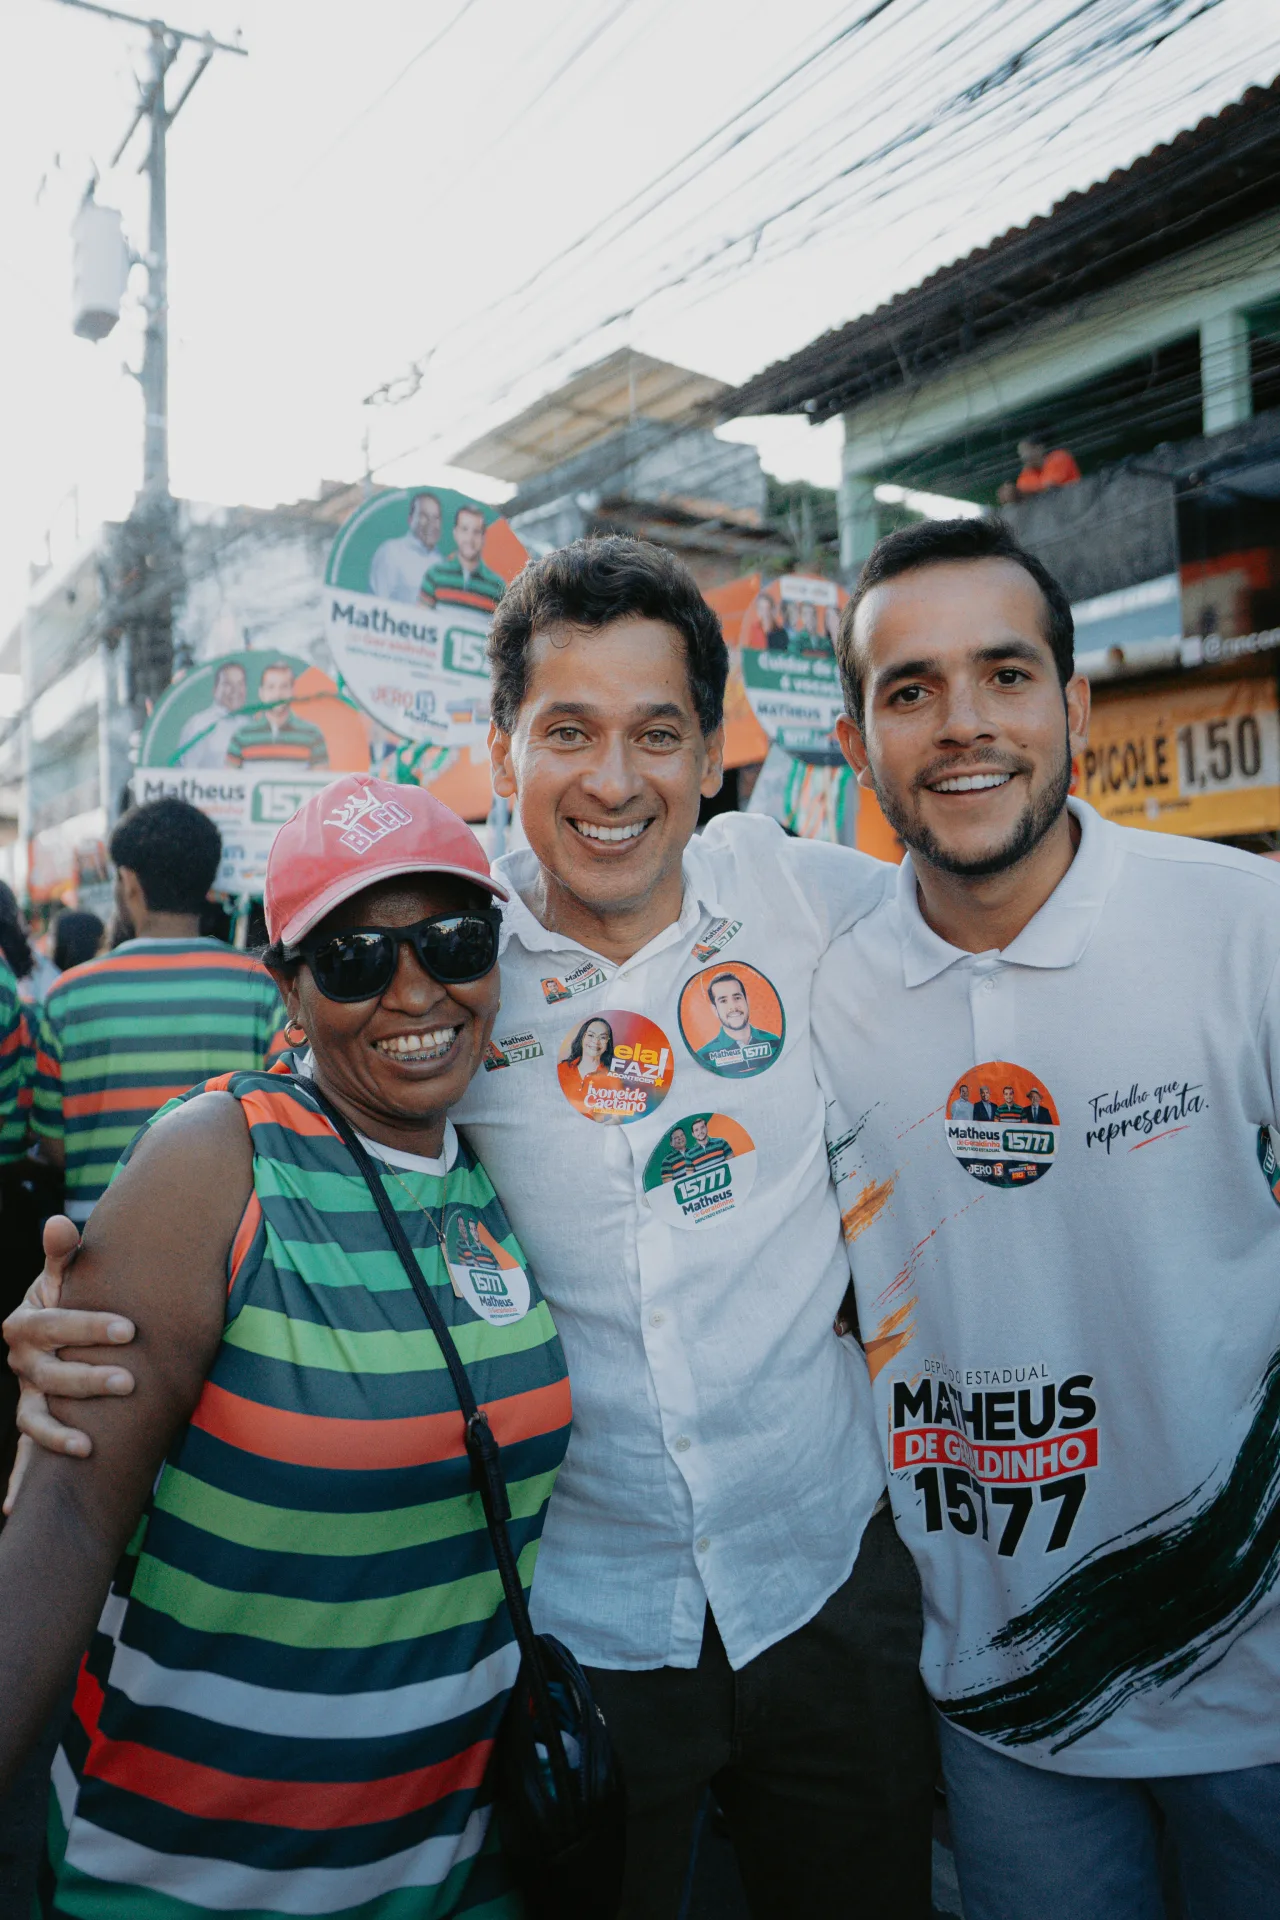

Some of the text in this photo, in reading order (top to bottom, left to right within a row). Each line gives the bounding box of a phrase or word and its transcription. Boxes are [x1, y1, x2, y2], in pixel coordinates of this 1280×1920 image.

[332, 601, 438, 644] Matheus
[1084, 714, 1262, 796] PICOLÉ 1,50
[143, 778, 246, 800] Matheus
[564, 962, 594, 983] Matheus
[500, 1034, 534, 1048] Matheus
[709, 1048, 741, 1060] Matheus
[743, 1044, 769, 1059] 15777
[505, 1042, 542, 1063] 15777
[613, 1043, 659, 1065] ela
[607, 1072, 655, 1085] ACONTECER
[583, 1094, 647, 1113] Caetano
[1088, 1081, 1179, 1123] Trabalho que
[1086, 1082, 1209, 1155] representa.
[948, 1126, 1051, 1152] Matheus 15777
[677, 1167, 727, 1201] 15777
[682, 1189, 733, 1216] Matheus
[700, 1198, 735, 1216] Geraldinho
[478, 1295, 514, 1308] Matheus
[924, 1359, 1049, 1386] DEPUDO ESTADUAL
[905, 1433, 938, 1463] DE
